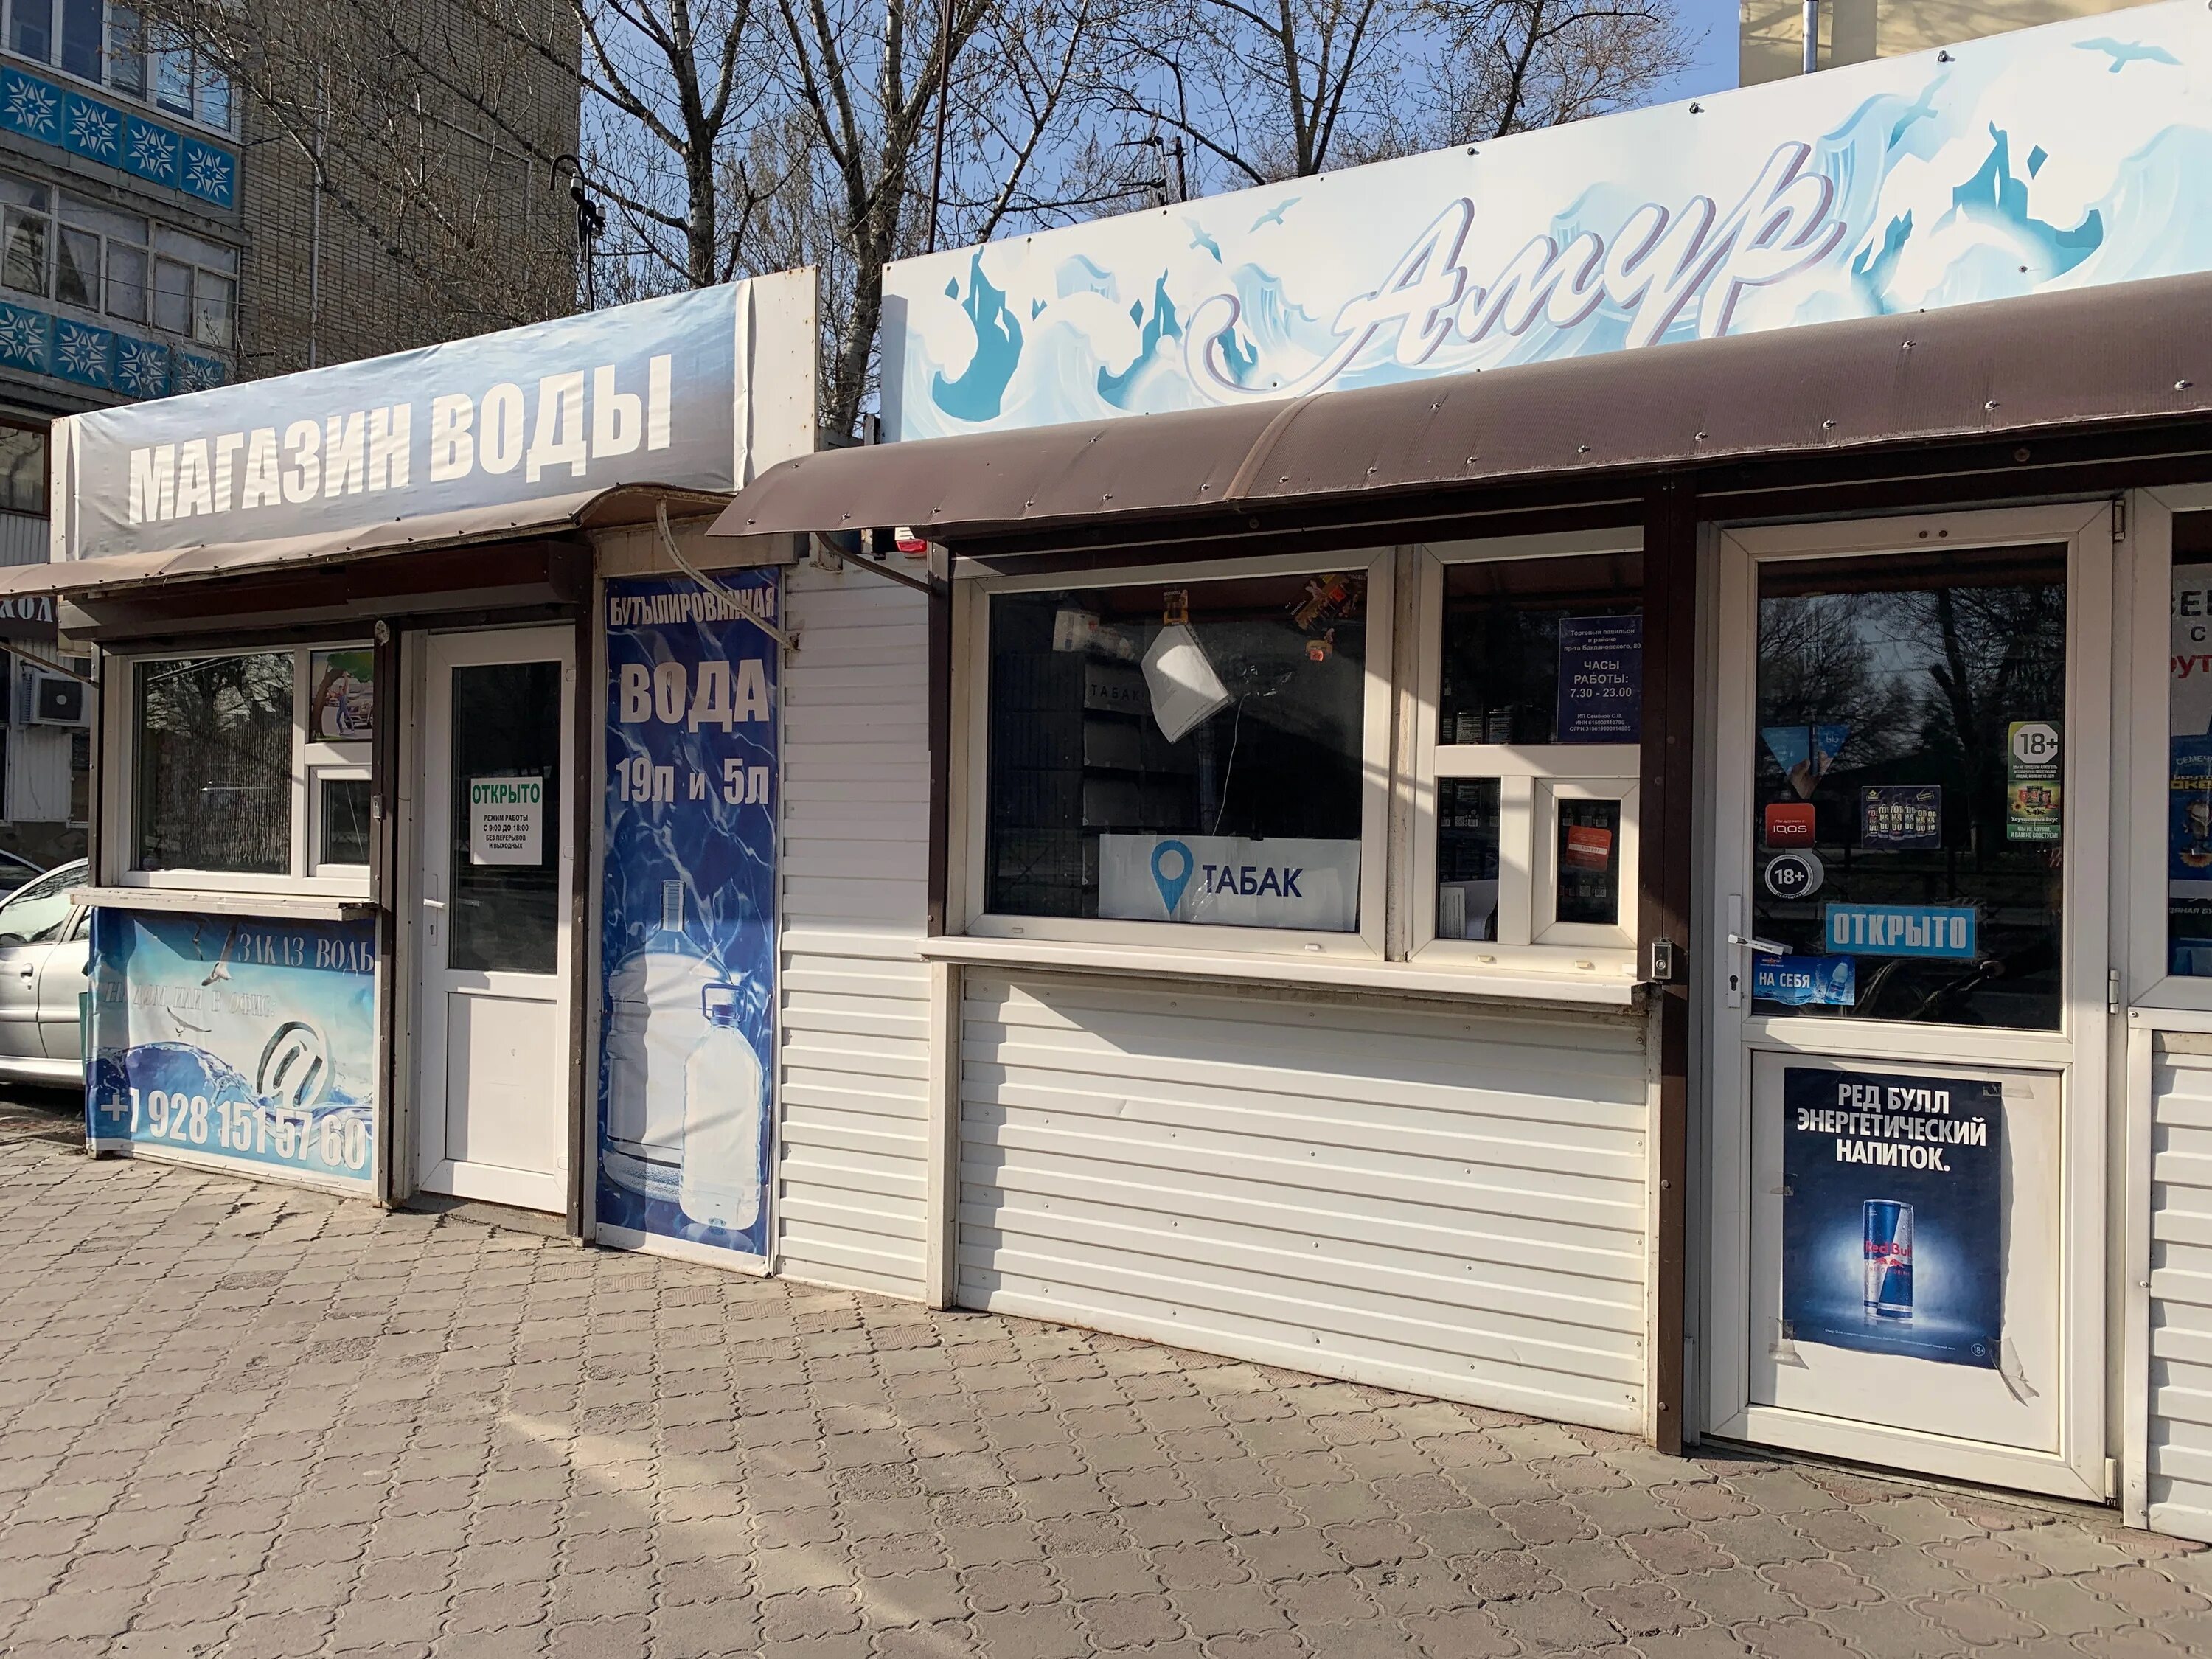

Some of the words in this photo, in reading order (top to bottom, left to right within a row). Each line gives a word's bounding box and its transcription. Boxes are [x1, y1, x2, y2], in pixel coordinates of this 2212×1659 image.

[1183, 140, 1846, 399] Амур
[129, 403, 411, 524] МАГАЗИН
[430, 353, 672, 483] ВОДЫ
[1574, 674, 1629, 684] РАБОТЫ:
[1584, 661, 1619, 670] ЧАСЫ
[620, 658, 770, 733] ВОДА
[1570, 688, 1593, 698] 7.30
[1603, 687, 1632, 698] 23.00
[2020, 733, 2058, 755] 18+
[472, 783, 540, 804] ОТКРЫТО
[616, 757, 674, 802] 19л
[689, 773, 705, 800] и
[723, 758, 769, 804] 5л
[502, 824, 512, 833] ДО
[1773, 825, 1807, 834] IQOS
[1203, 864, 1304, 898] ТАБАК
[1775, 869, 1805, 885] 18+
[1834, 912, 1966, 949] ОТКРЫТО
[1759, 972, 1775, 987] НА
[1779, 973, 1811, 989] СЕБЯ
[1838, 1083, 1881, 1113] РЕД
[1888, 1087, 1949, 1115] БУЛЛ
[148, 1090, 209, 1144] 928
[217, 1099, 266, 1155] 151
[275, 1107, 313, 1161] 57
[321, 1114, 366, 1171] 60
[1798, 1107, 1986, 1147] ЭНЕРГЕТИЧЕСКИЙ
[1837, 1138, 1951, 1172] НАПИТОК.
[1865, 1239, 1889, 1253] Red
[1891, 1242, 1912, 1256] Bull
